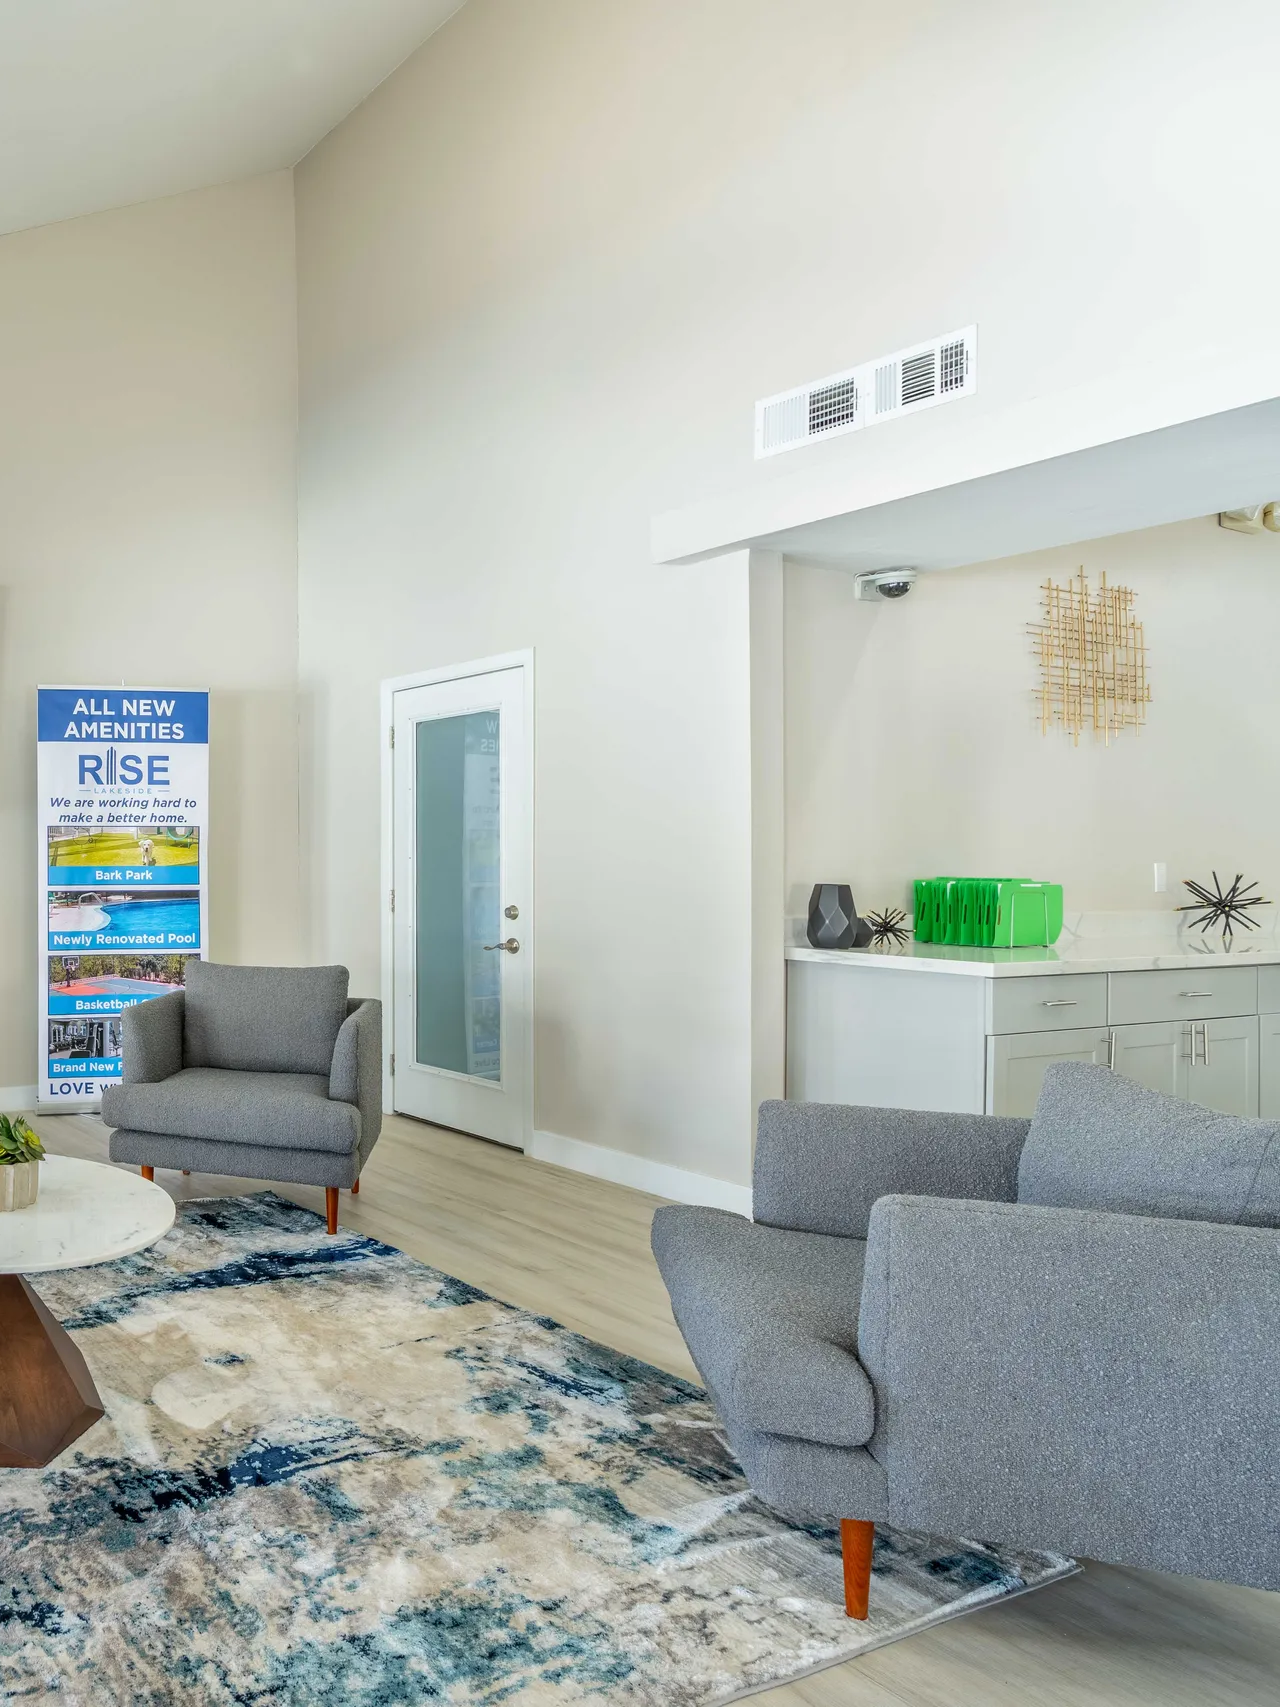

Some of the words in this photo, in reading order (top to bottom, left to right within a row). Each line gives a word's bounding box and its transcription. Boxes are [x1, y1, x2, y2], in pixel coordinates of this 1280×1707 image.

[73, 698, 116, 716] ALL
[122, 699, 176, 717] NEW
[64, 721, 185, 740] AMENITIES
[78, 746, 171, 786] RISE
[50, 797, 71, 808] We
[74, 798, 95, 808] are
[98, 797, 149, 809] working
[152, 797, 182, 808] hard
[184, 798, 197, 808] to
[58, 812, 93, 823] make
[96, 814, 104, 823] a
[107, 812, 146, 823] better
[149, 812, 188, 823] home.
[95, 870, 122, 880] Bark
[125, 870, 153, 880] Park
[53, 934, 93, 947] Newly
[96, 933, 164, 944] Renovated
[168, 932, 196, 944] Pool
[53, 1062, 86, 1073] Brand
[89, 1061, 115, 1072] New
[50, 1082, 95, 1096] LOVE
